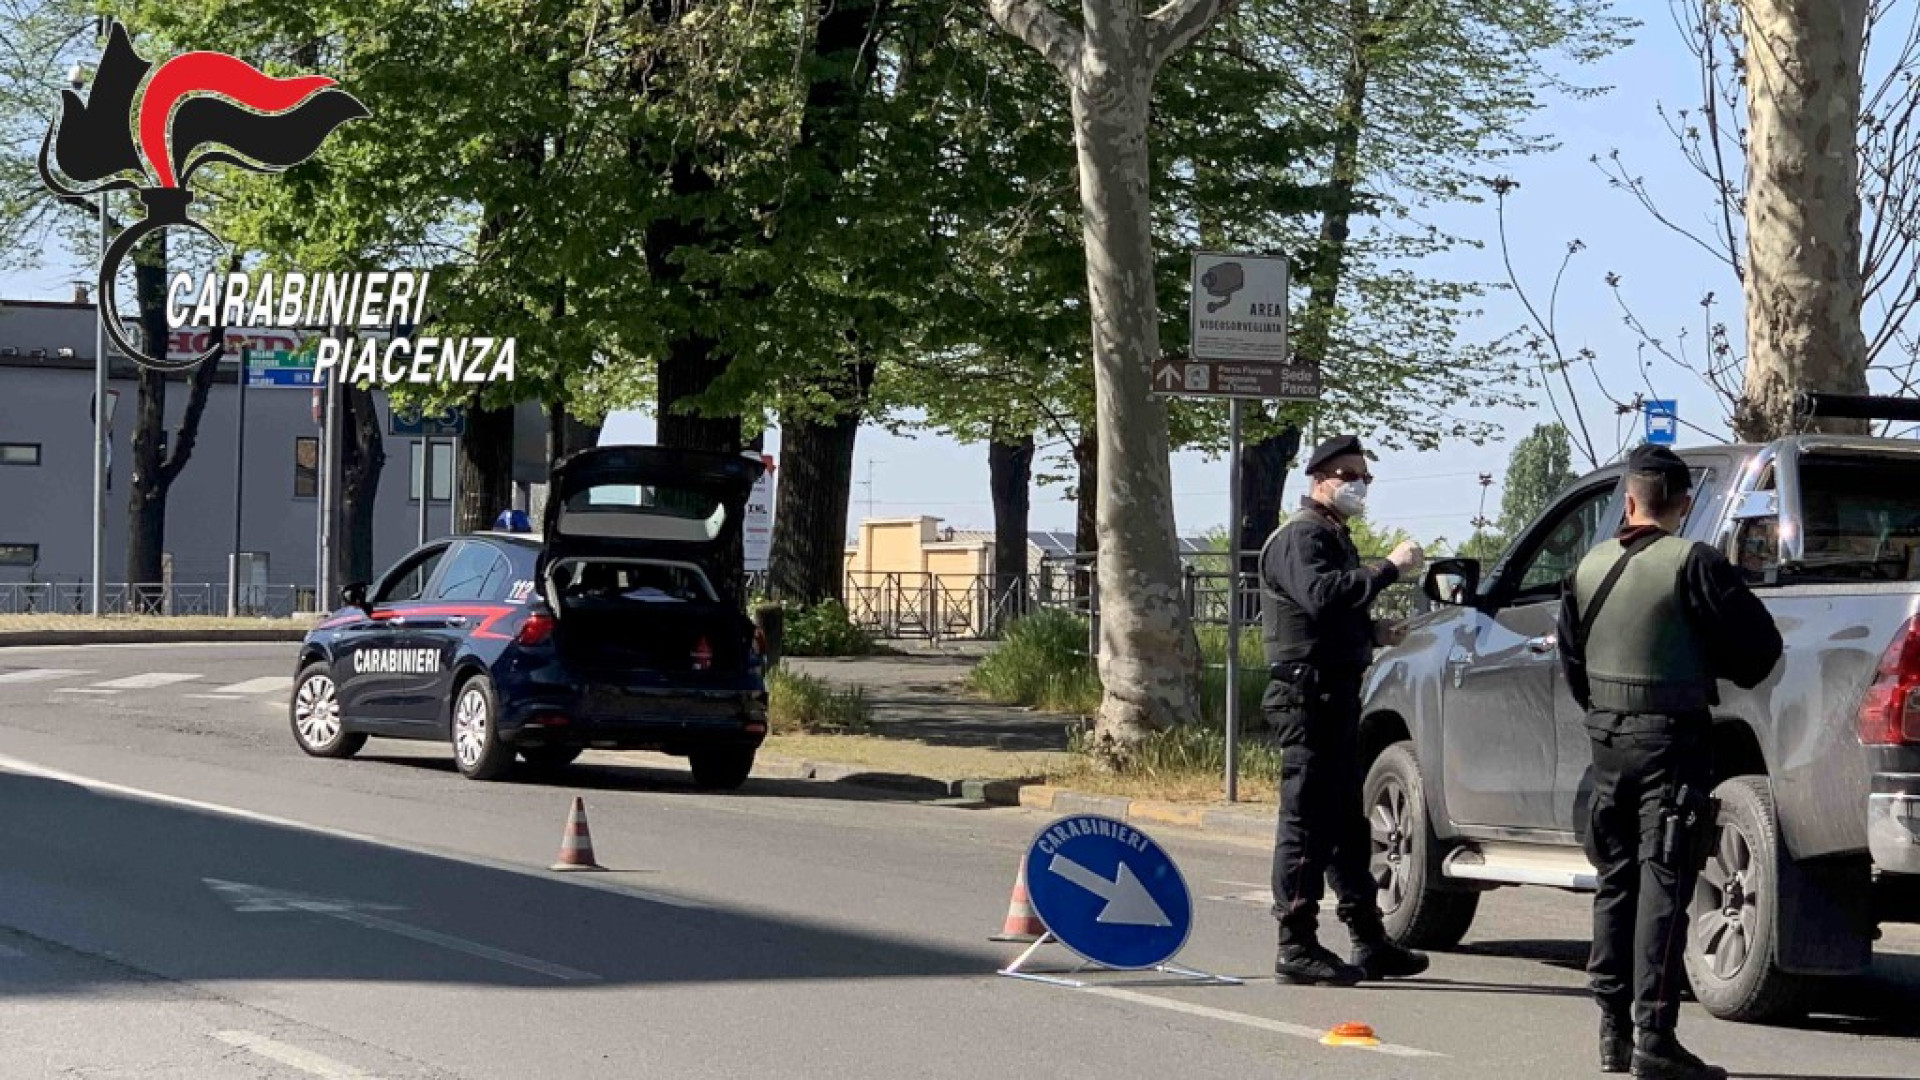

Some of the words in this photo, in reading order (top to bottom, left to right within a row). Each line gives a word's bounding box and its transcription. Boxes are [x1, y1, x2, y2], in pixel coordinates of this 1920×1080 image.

[1250, 303, 1281, 317] AREA
[1281, 367, 1313, 382] Sede
[1281, 382, 1317, 394] Parco
[508, 579, 535, 599] 112
[353, 649, 441, 673] CARABINIERI
[1038, 818, 1149, 854] CARABINIERI
